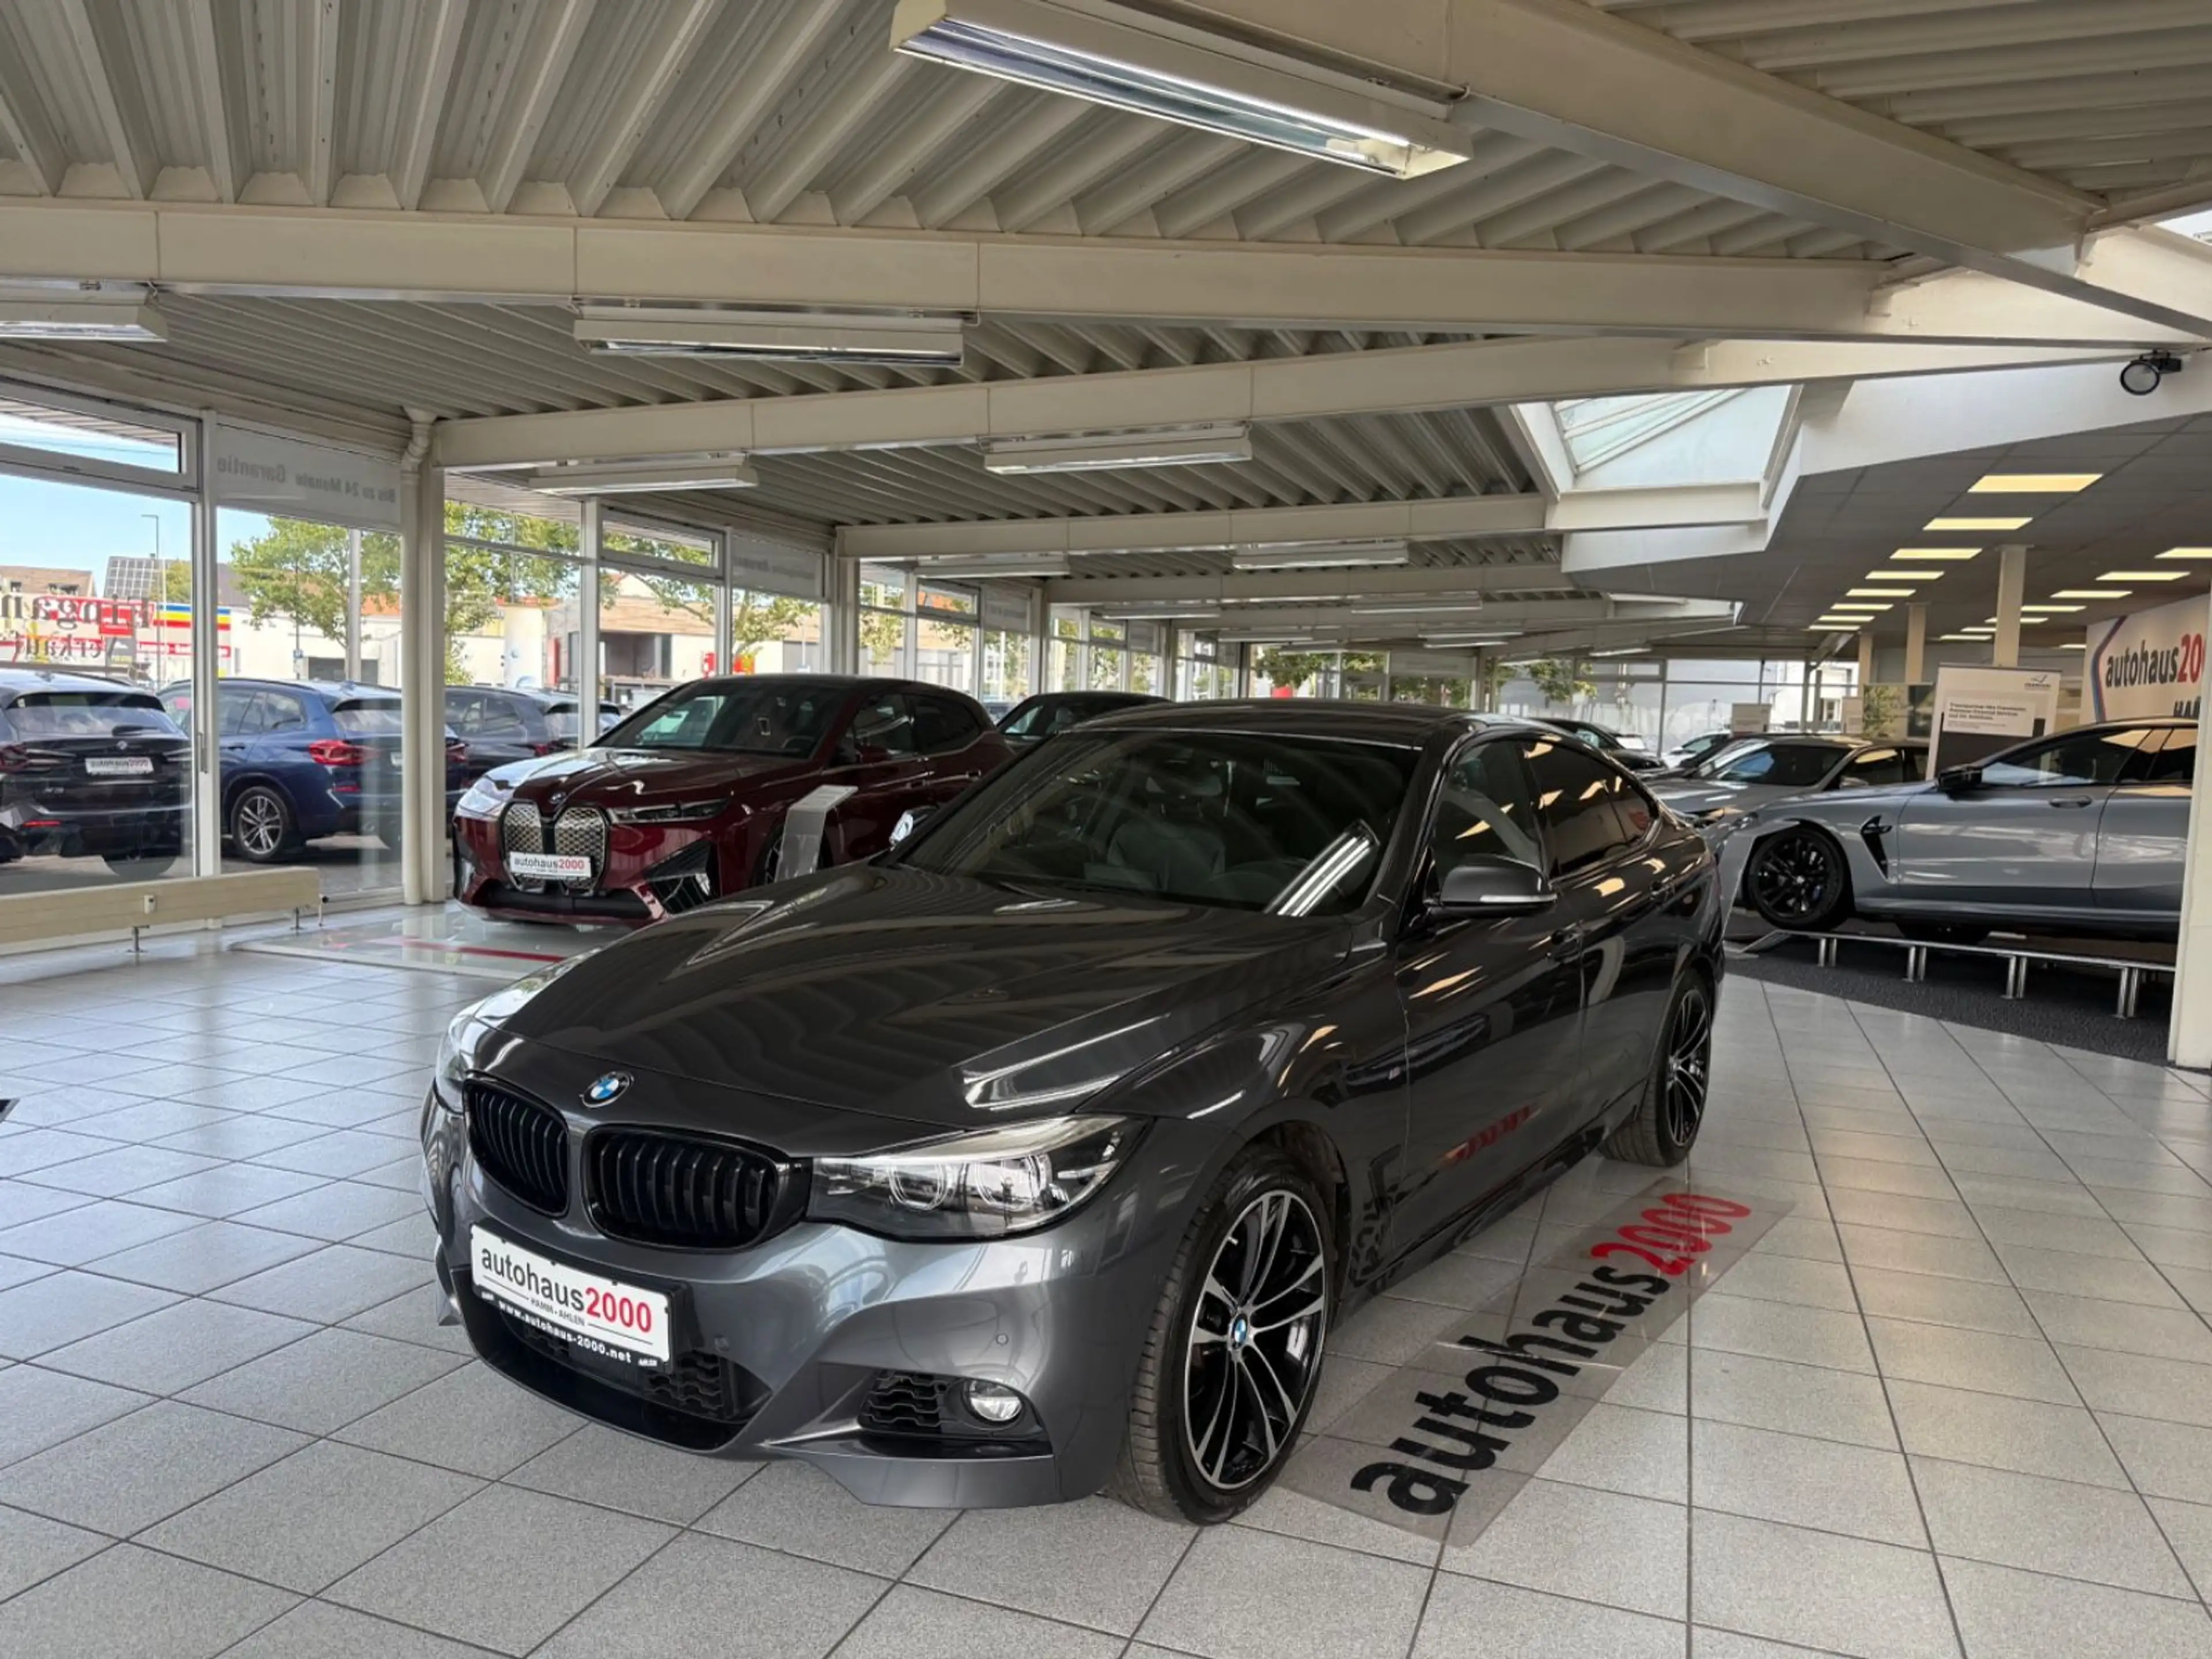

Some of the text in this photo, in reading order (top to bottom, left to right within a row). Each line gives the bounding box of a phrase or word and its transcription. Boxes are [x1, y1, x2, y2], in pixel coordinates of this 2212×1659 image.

[2106, 633, 2206, 688] autohaus20
[514, 857, 585, 870] autohaus2000
[481, 1247, 652, 1333] autohaus2000
[498, 1300, 632, 1363] www.autohaus-2000.net
[1350, 1193, 1751, 1516] autohaus2000
